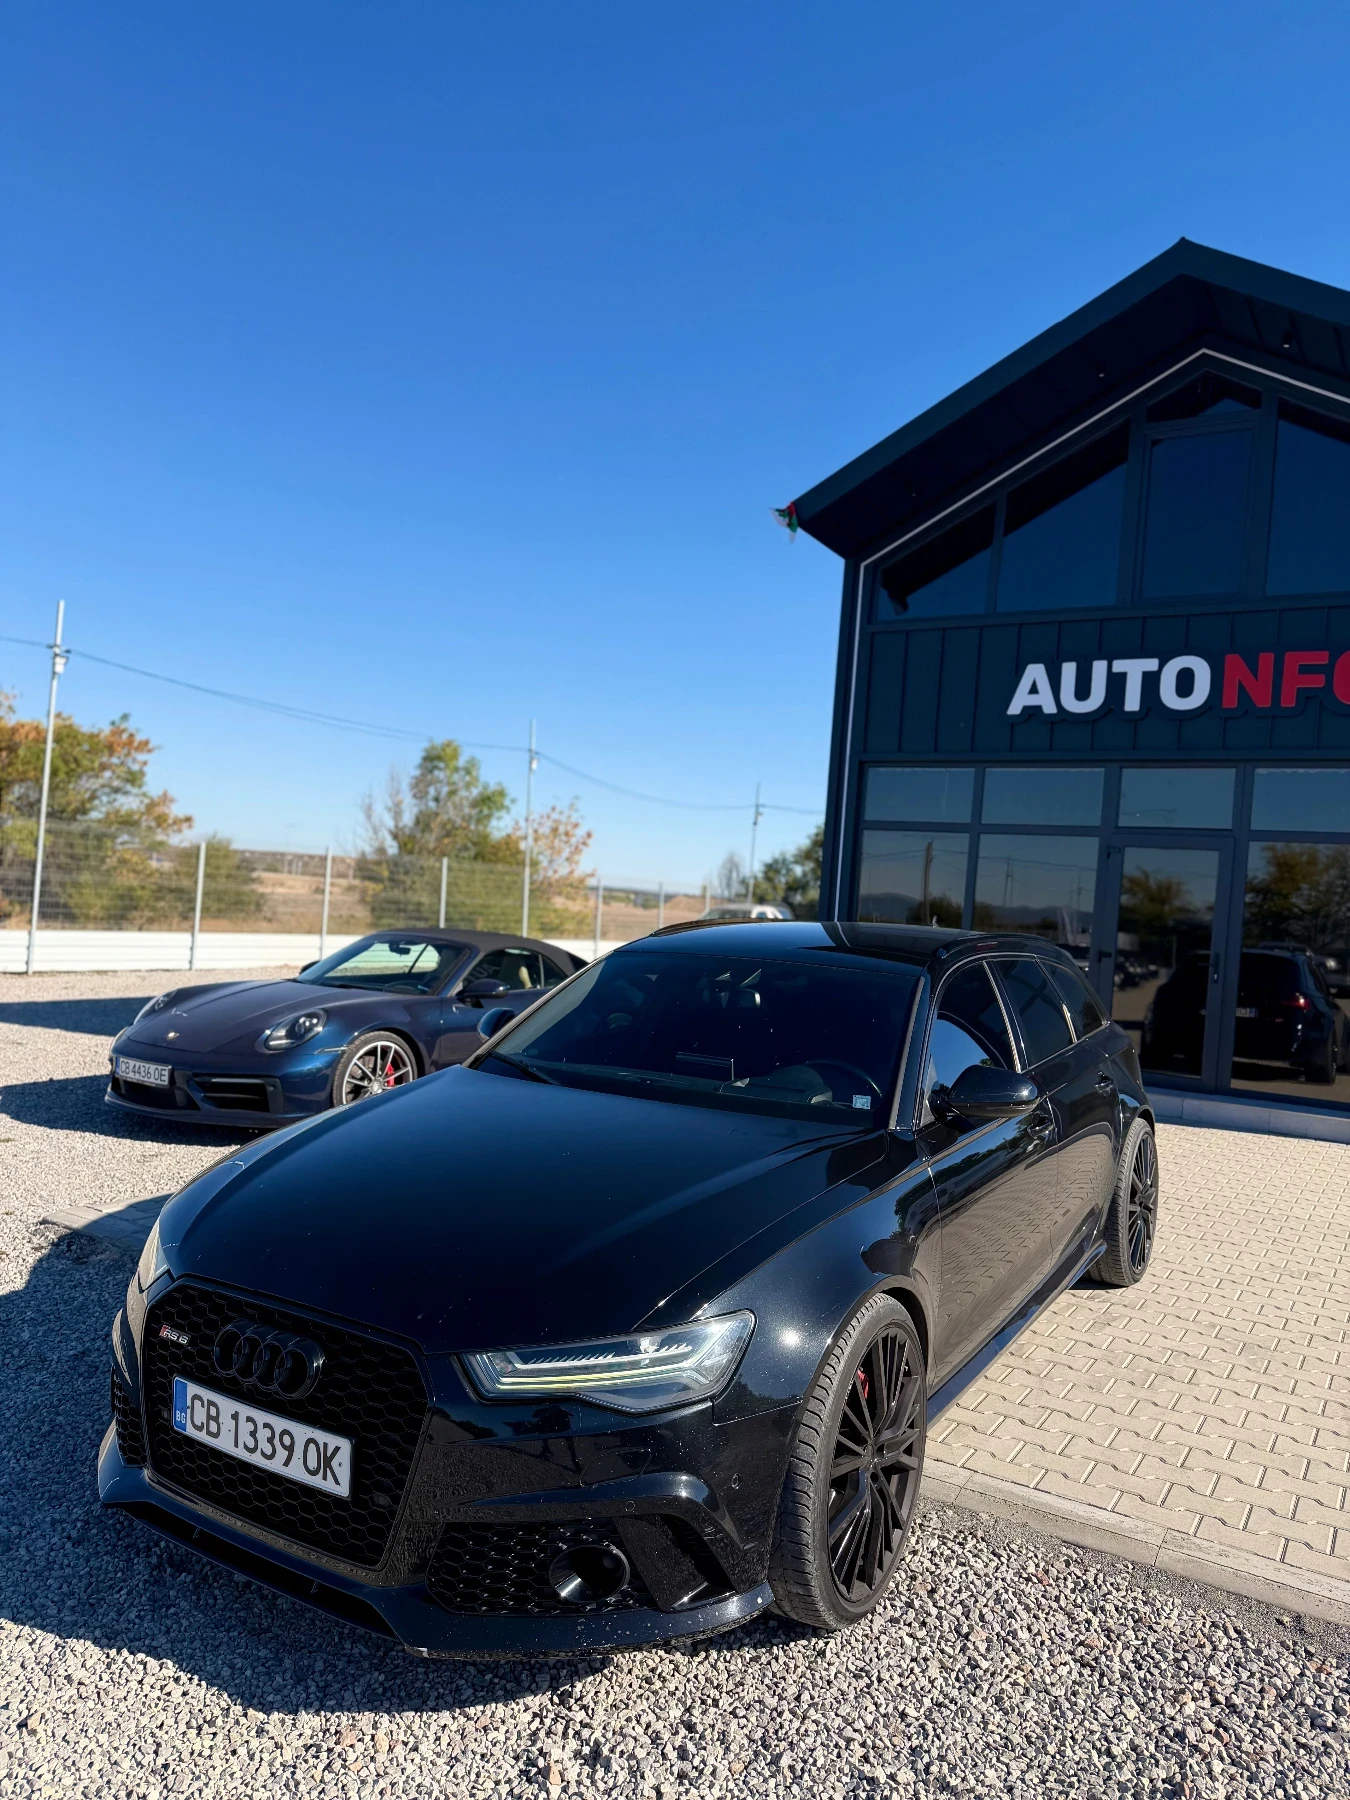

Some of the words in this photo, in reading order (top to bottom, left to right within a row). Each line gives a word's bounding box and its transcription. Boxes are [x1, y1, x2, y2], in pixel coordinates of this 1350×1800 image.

[1006, 655, 1212, 715] AUTO
[120, 1060, 130, 1075] CB
[131, 1063, 152, 1080] 4436
[176, 1410, 186, 1424] BG
[190, 1393, 221, 1439] CB
[230, 1410, 295, 1468] 1339
[302, 1437, 342, 1486] OK
